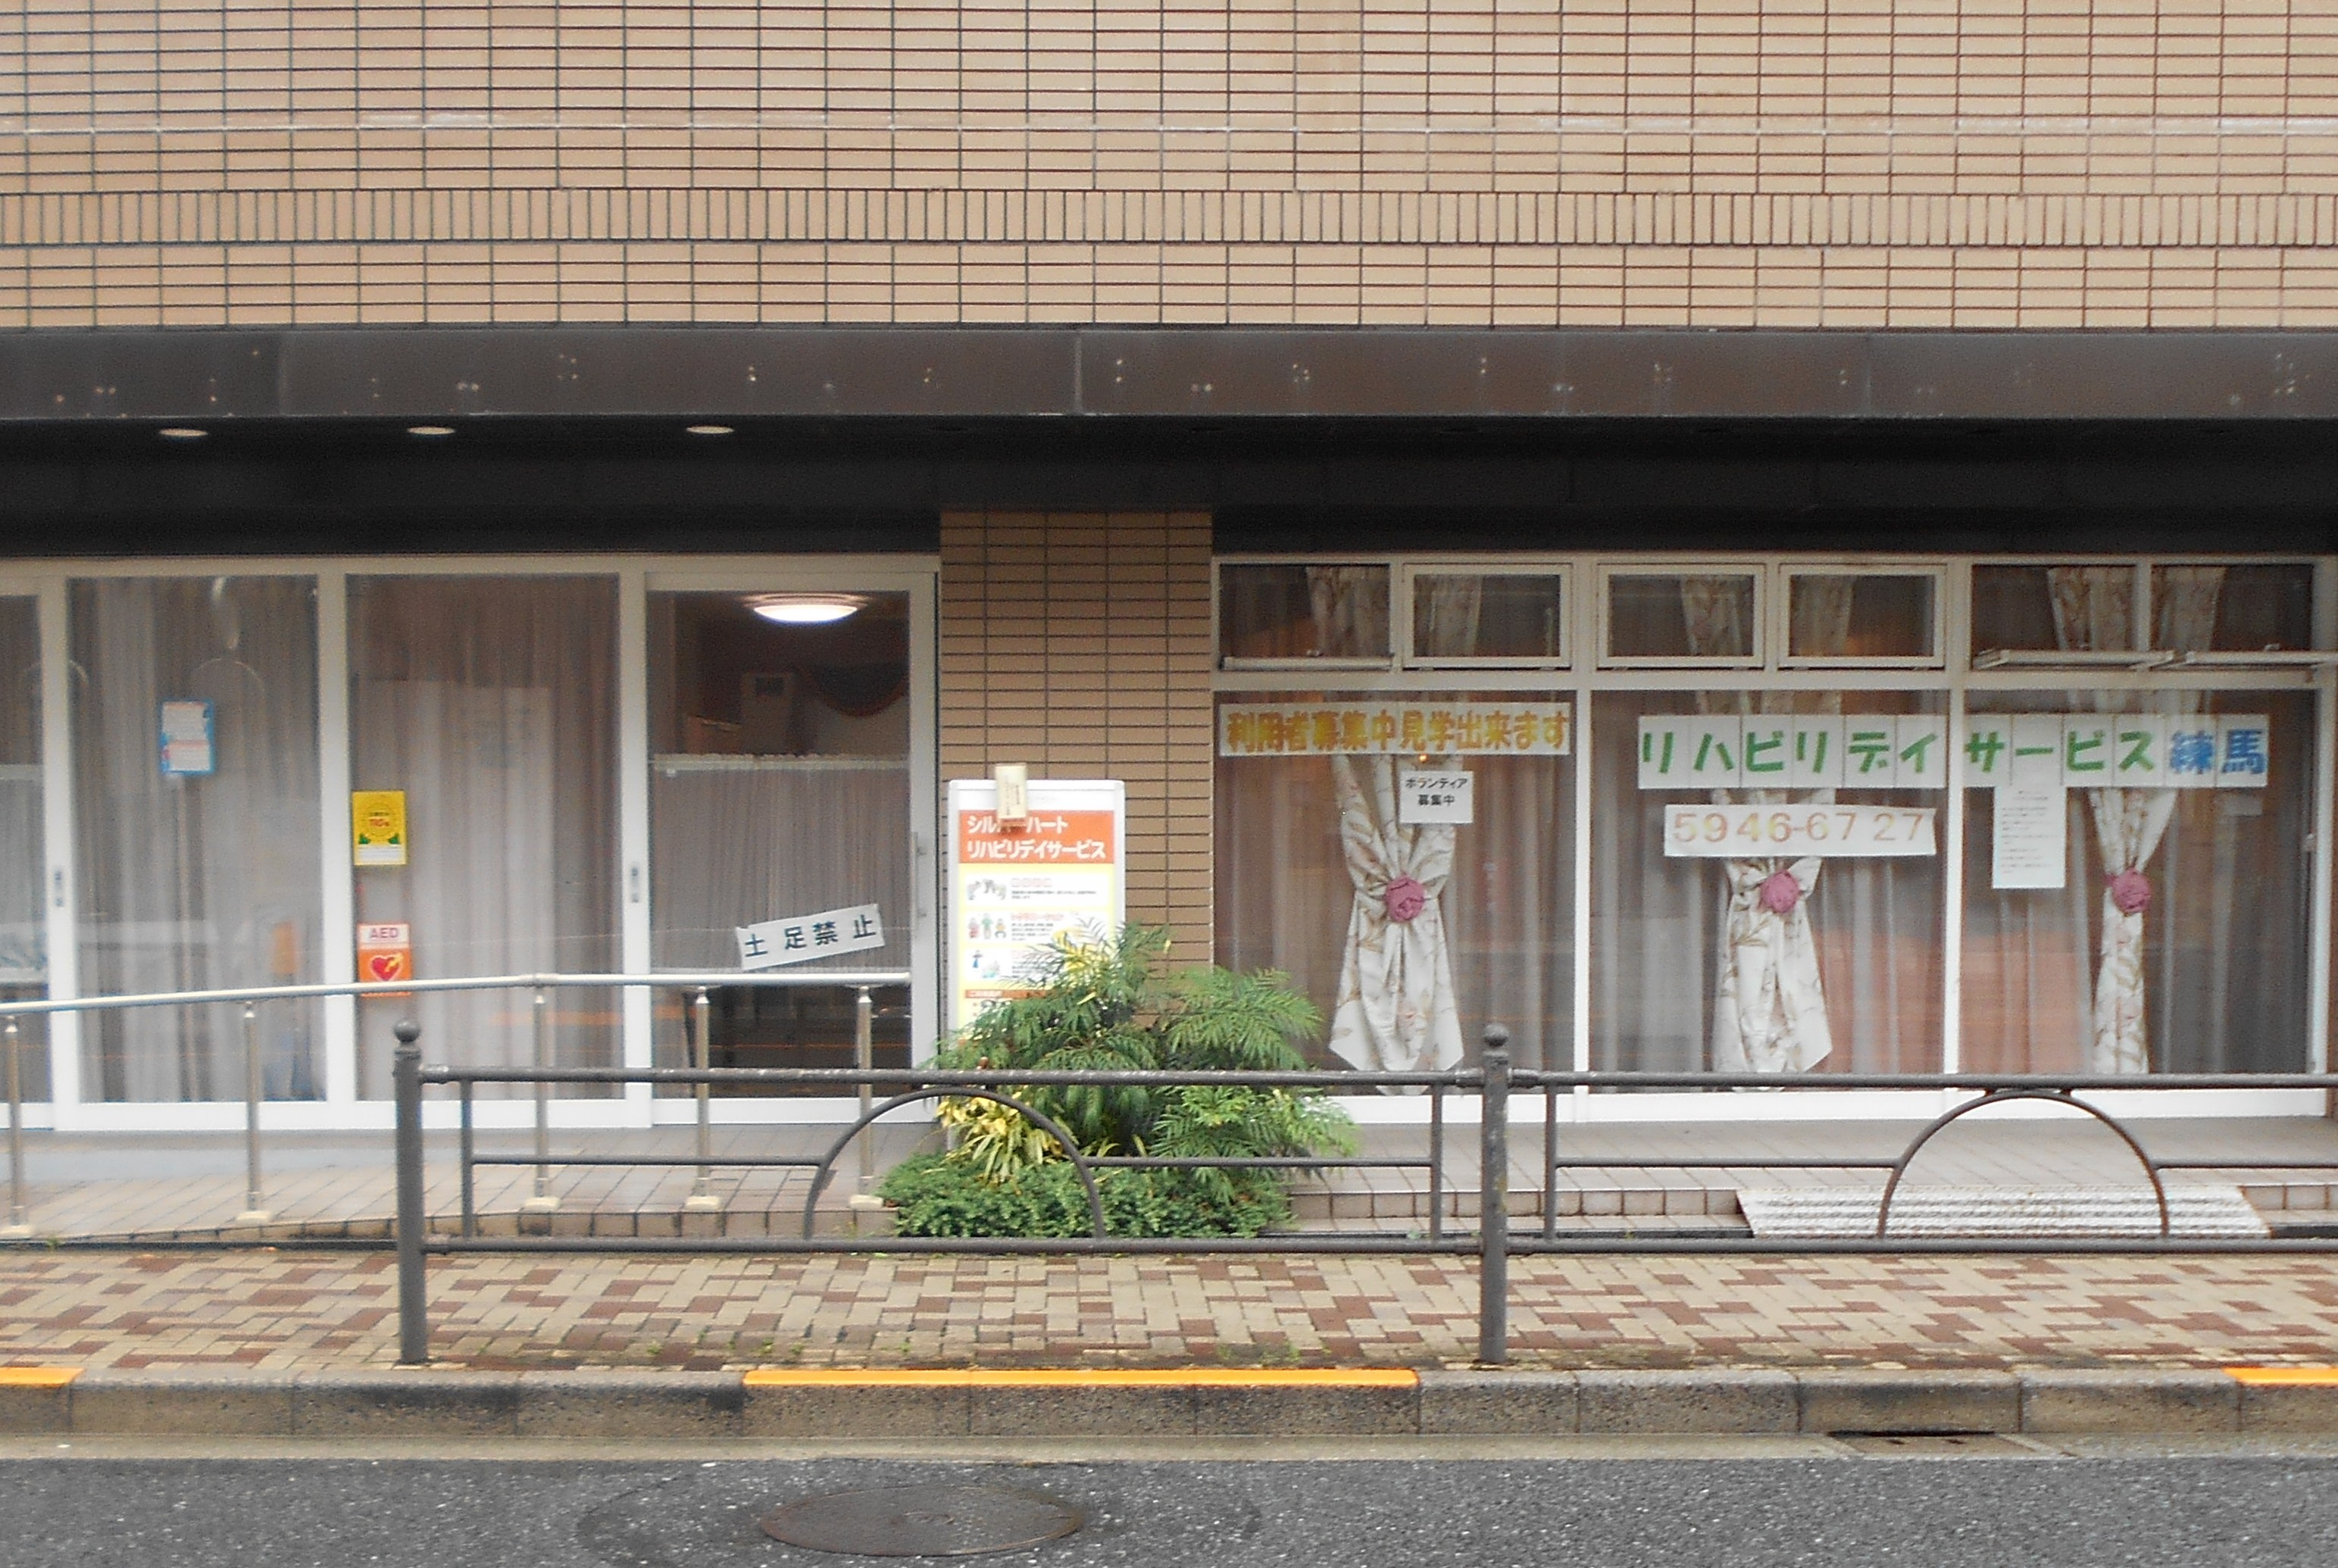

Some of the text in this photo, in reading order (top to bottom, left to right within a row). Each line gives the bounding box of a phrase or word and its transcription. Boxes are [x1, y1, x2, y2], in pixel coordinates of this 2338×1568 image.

[1418, 793, 1455, 807] 募集中
[967, 815, 1069, 834] シルハート
[370, 927, 399, 939] AED
[744, 914, 877, 957] 土足禁止
